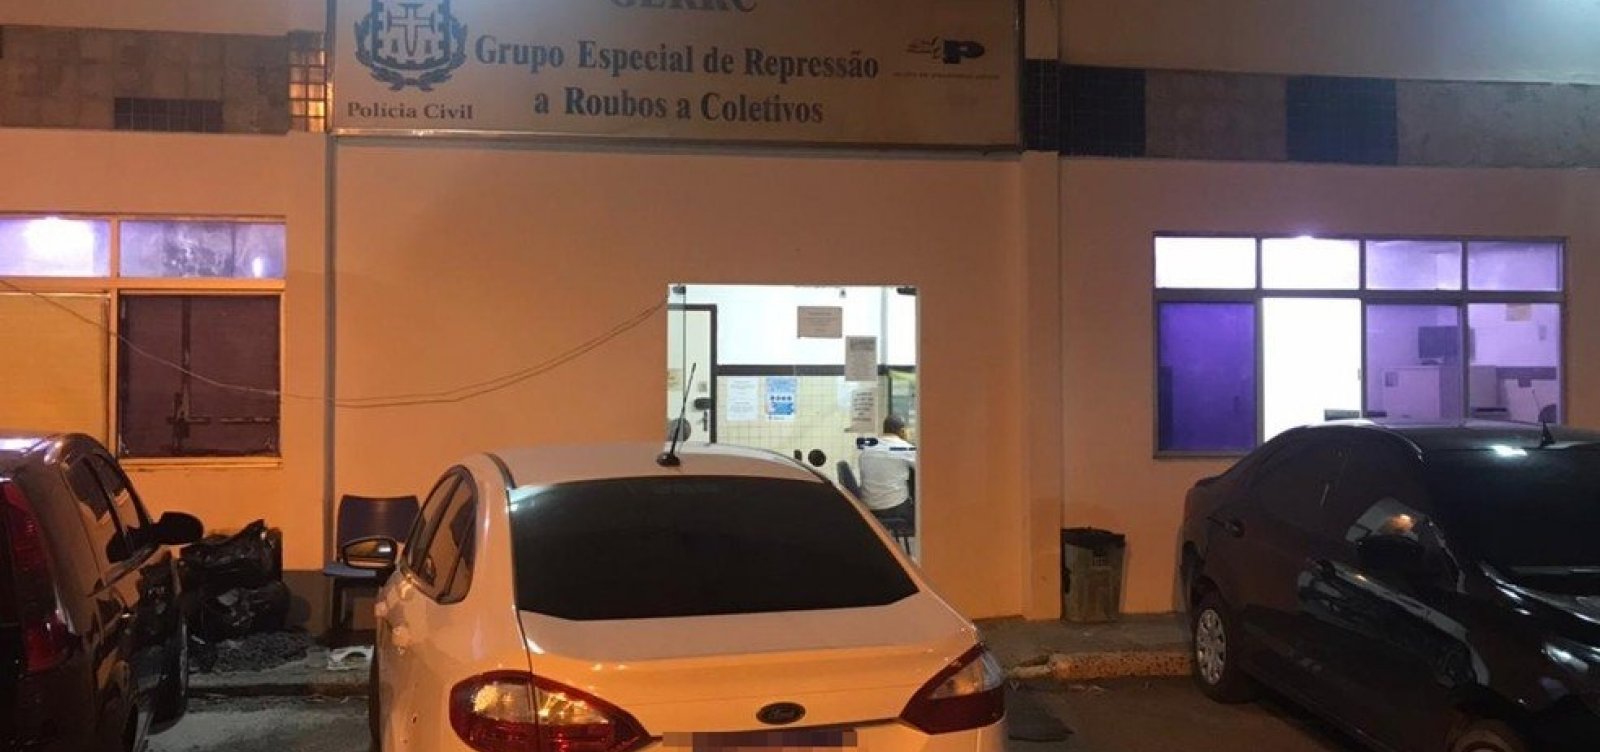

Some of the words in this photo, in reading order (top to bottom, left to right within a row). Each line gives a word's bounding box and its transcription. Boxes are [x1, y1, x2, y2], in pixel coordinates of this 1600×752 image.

[475, 34, 565, 73] Grupo
[577, 40, 694, 76] Especial
[703, 46, 736, 75] de
[743, 48, 879, 84] Repressão
[423, 102, 474, 120] Civil
[534, 91, 550, 114] a
[565, 87, 668, 120] Roubos
[676, 96, 691, 121] a
[700, 91, 824, 124] Coletivos
